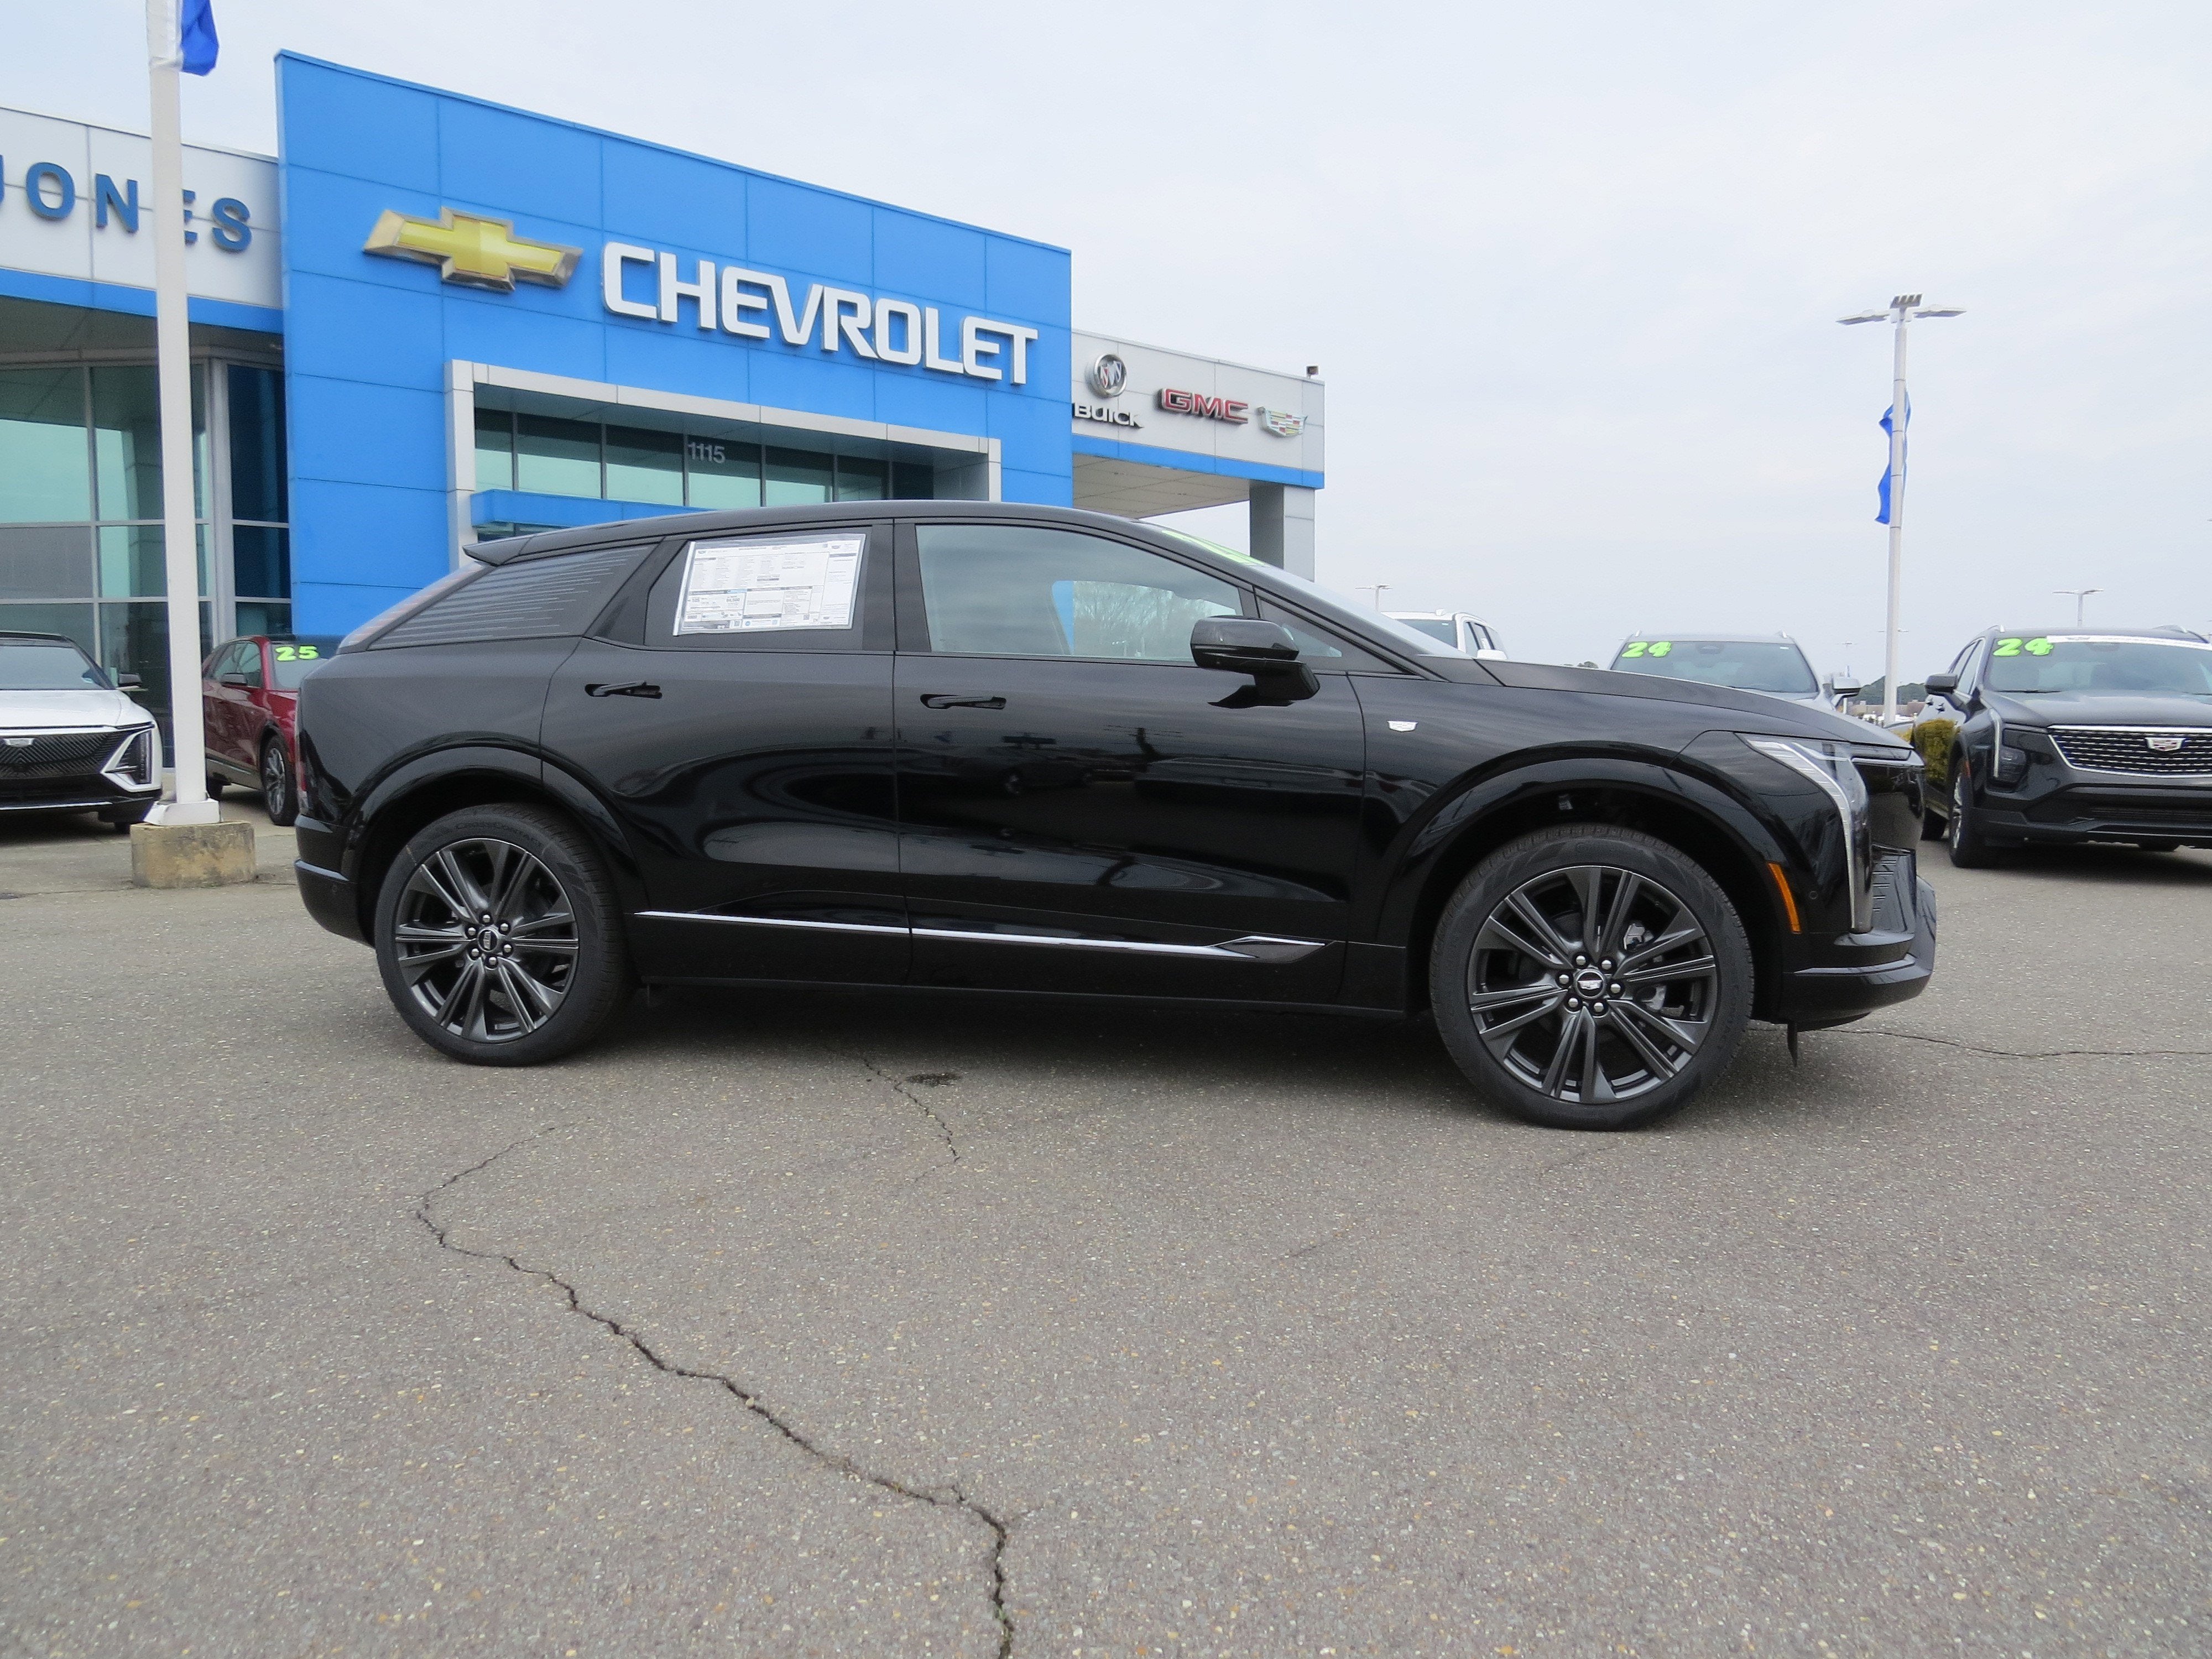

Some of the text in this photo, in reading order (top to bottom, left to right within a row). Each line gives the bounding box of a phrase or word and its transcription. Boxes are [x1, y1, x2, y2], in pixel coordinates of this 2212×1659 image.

[0, 155, 253, 252] ONS
[602, 242, 1039, 385] CHEVROLET
[1073, 402, 1142, 428] BUICK
[1162, 388, 1249, 424] GMC
[688, 441, 726, 464] 1115
[275, 644, 320, 662] 25
[1621, 640, 1672, 658] 24
[1993, 637, 2054, 657] 24
